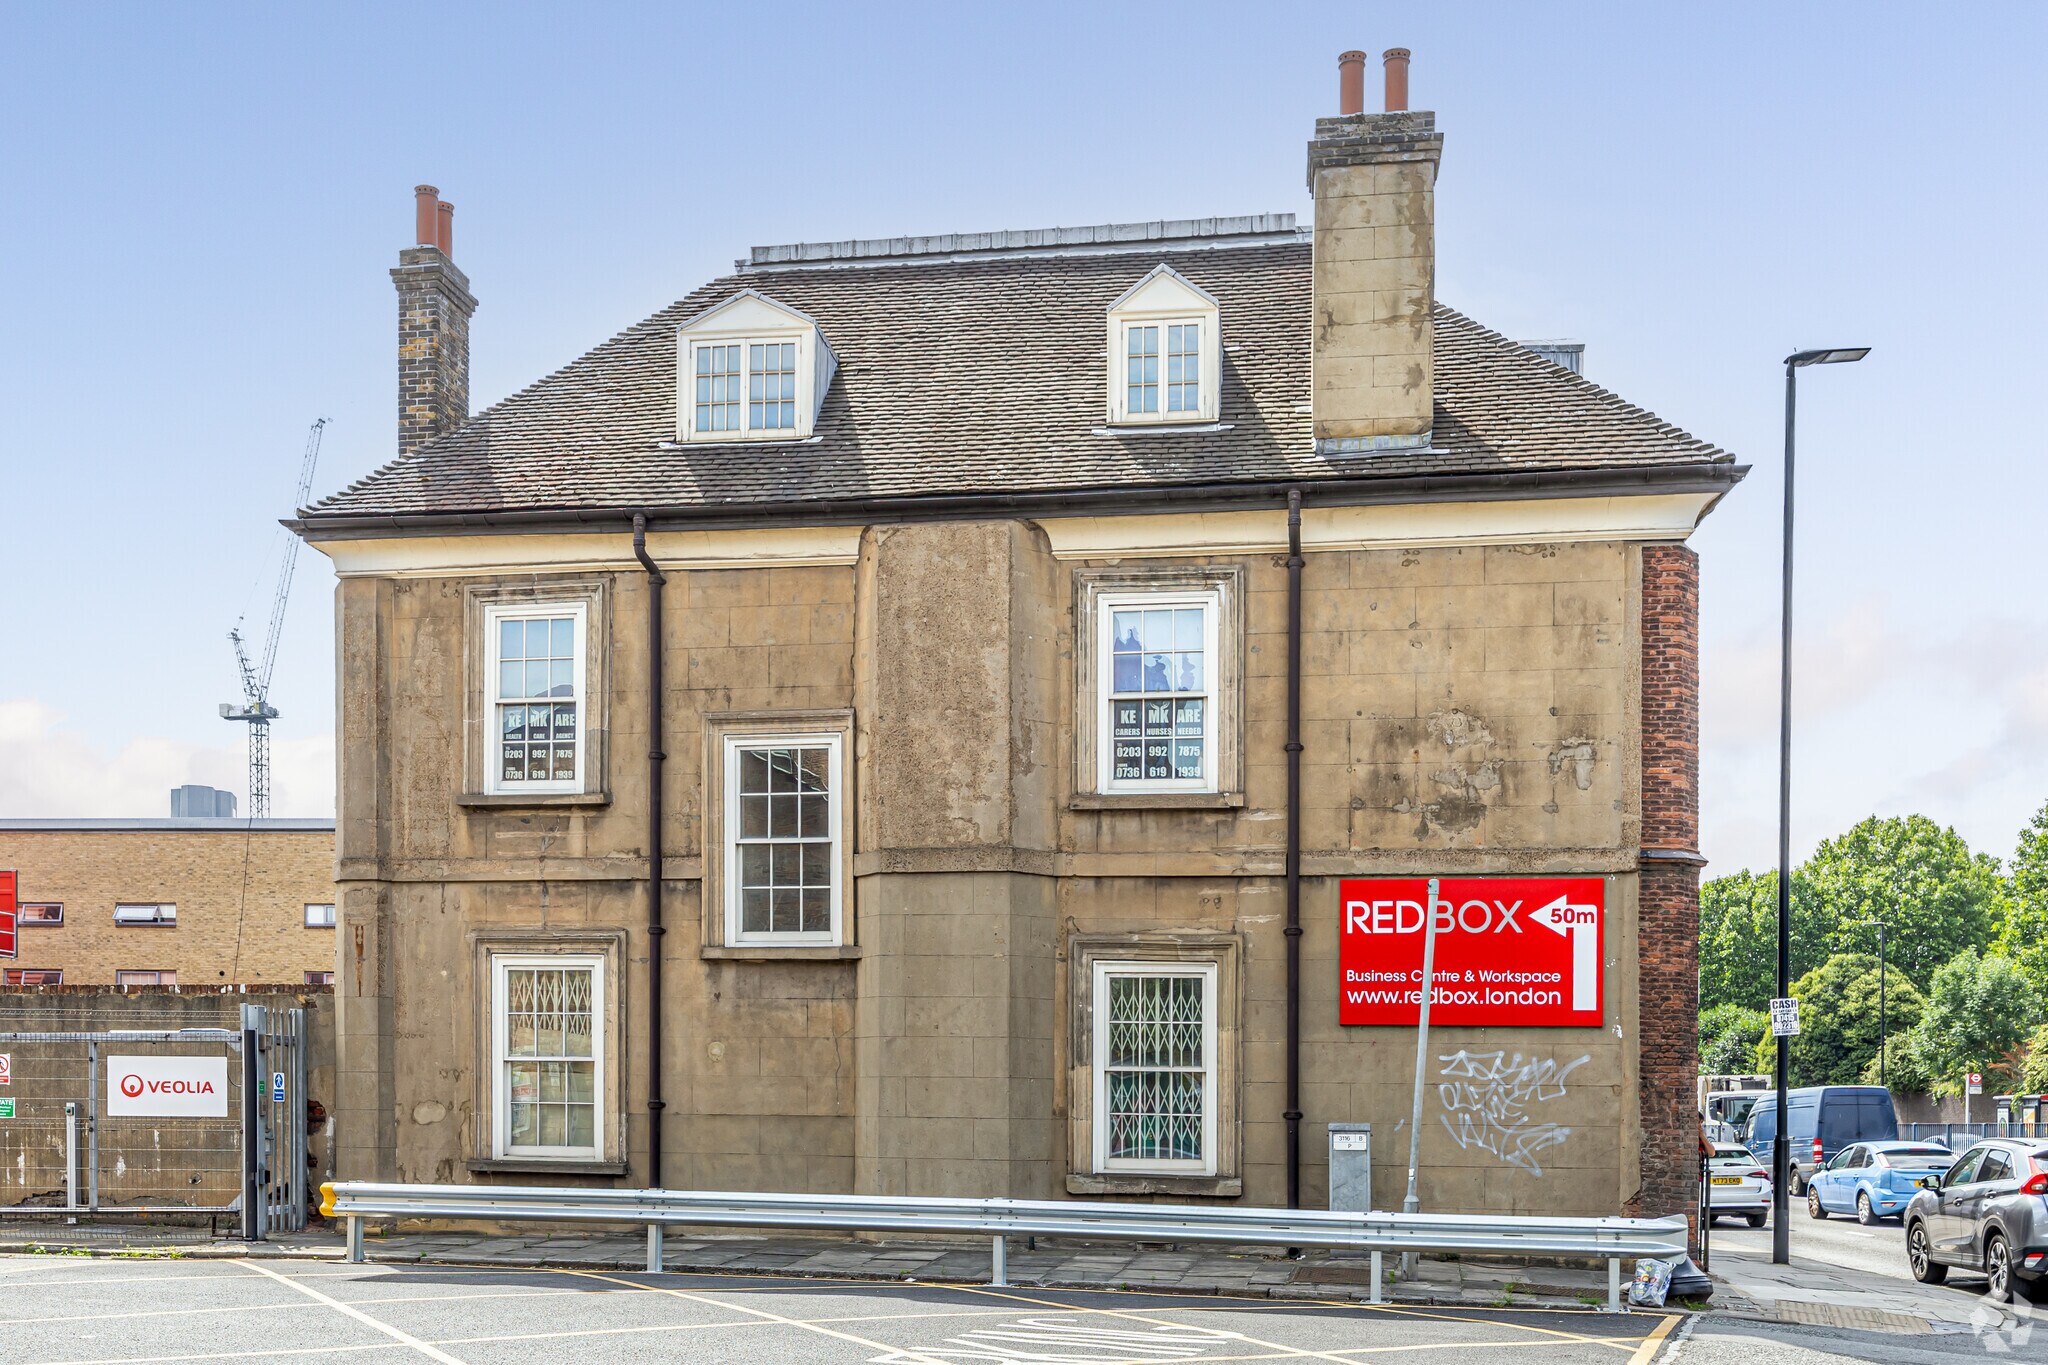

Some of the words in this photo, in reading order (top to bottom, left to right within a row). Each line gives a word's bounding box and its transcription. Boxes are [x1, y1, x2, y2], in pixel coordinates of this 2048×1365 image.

[509, 715, 521, 727] KE
[555, 714, 575, 726] ARE
[1121, 710, 1136, 724] KE
[1176, 709, 1201, 722] ARE
[505, 750, 523, 758] 0203
[532, 750, 546, 758] 992
[556, 750, 573, 758] 7875
[1117, 747, 1141, 757] 0203
[1149, 746, 1167, 756] 992
[1178, 746, 1200, 756] 7875
[506, 771, 523, 779] 0736
[532, 770, 545, 778] 619
[1116, 767, 1139, 777] 0736
[1150, 767, 1167, 777] 619
[1178, 767, 1201, 777] 1939
[1346, 900, 1523, 934] REDBOX
[1550, 908, 1595, 924] 50m
[1346, 970, 1406, 982] Business
[1411, 970, 1460, 982] Cntre
[1464, 970, 1475, 982] &
[1479, 970, 1561, 985] Workspace
[1347, 988, 1561, 1005] www.redbox.london
[1772, 1000, 1796, 1009] CASH
[148, 1081, 214, 1093] VEOLIA
